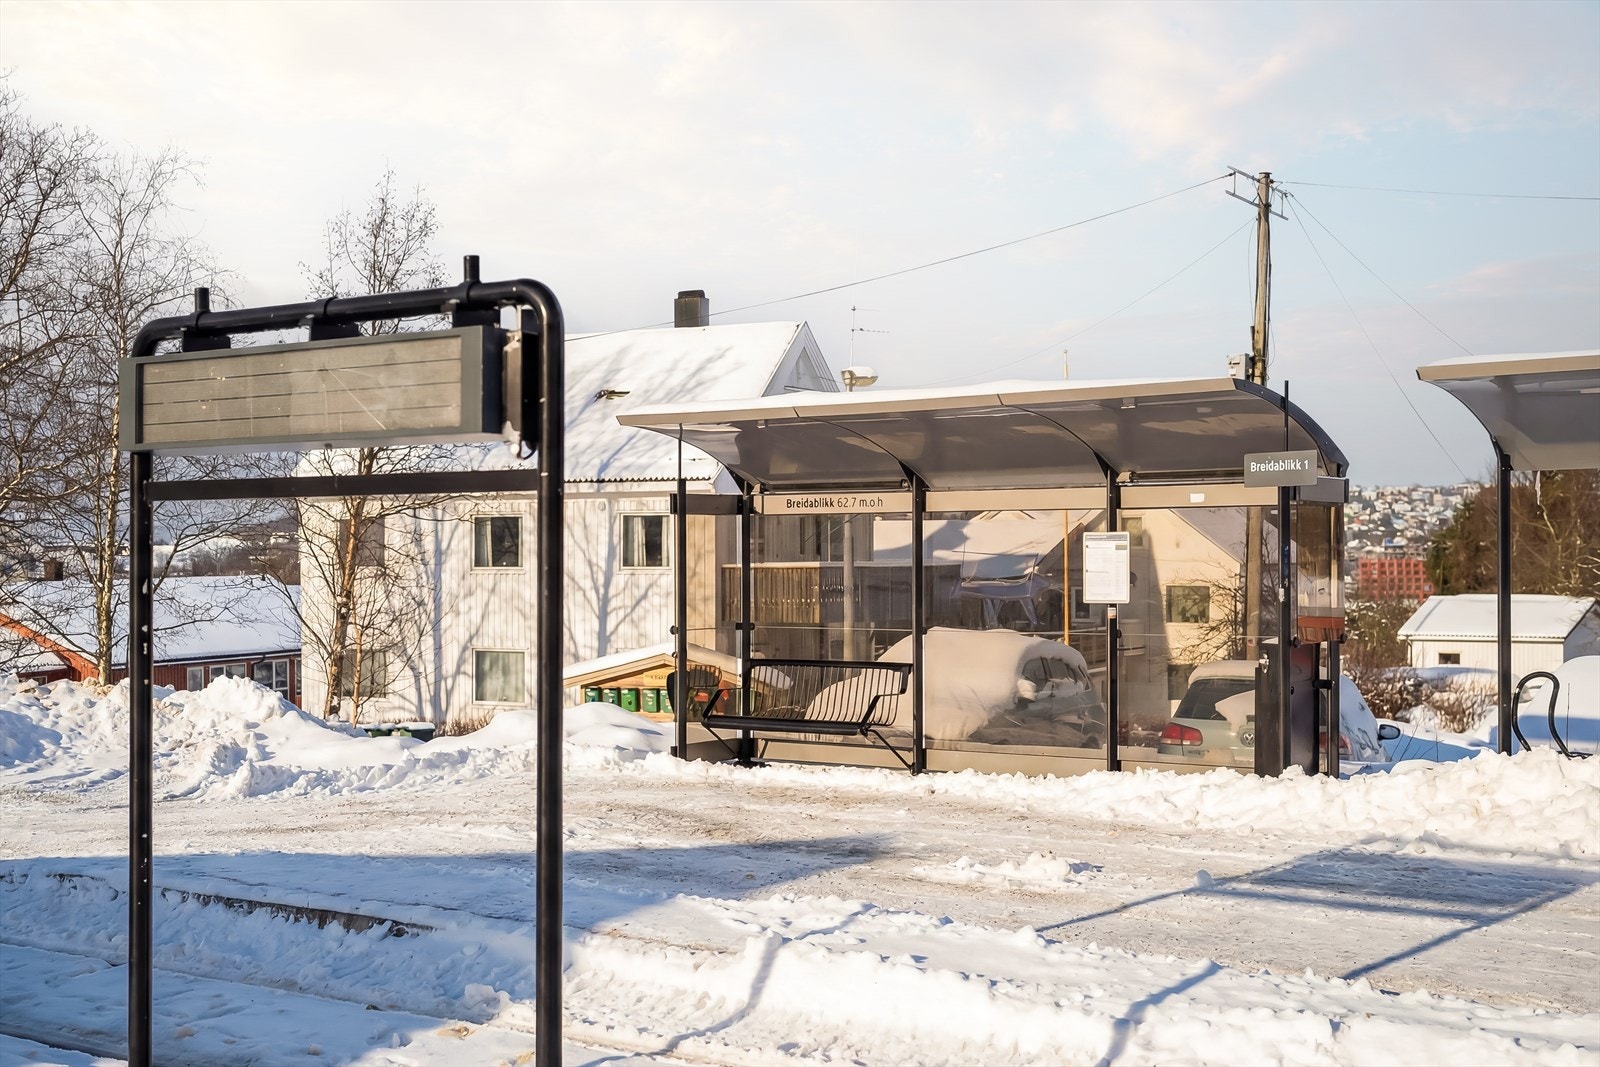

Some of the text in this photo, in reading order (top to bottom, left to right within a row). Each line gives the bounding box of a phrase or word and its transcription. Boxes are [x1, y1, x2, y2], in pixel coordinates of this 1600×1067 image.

[1250, 458, 1309, 471] Breidablikk 1
[786, 497, 835, 508] Breidablikk
[837, 497, 857, 508] 62.7
